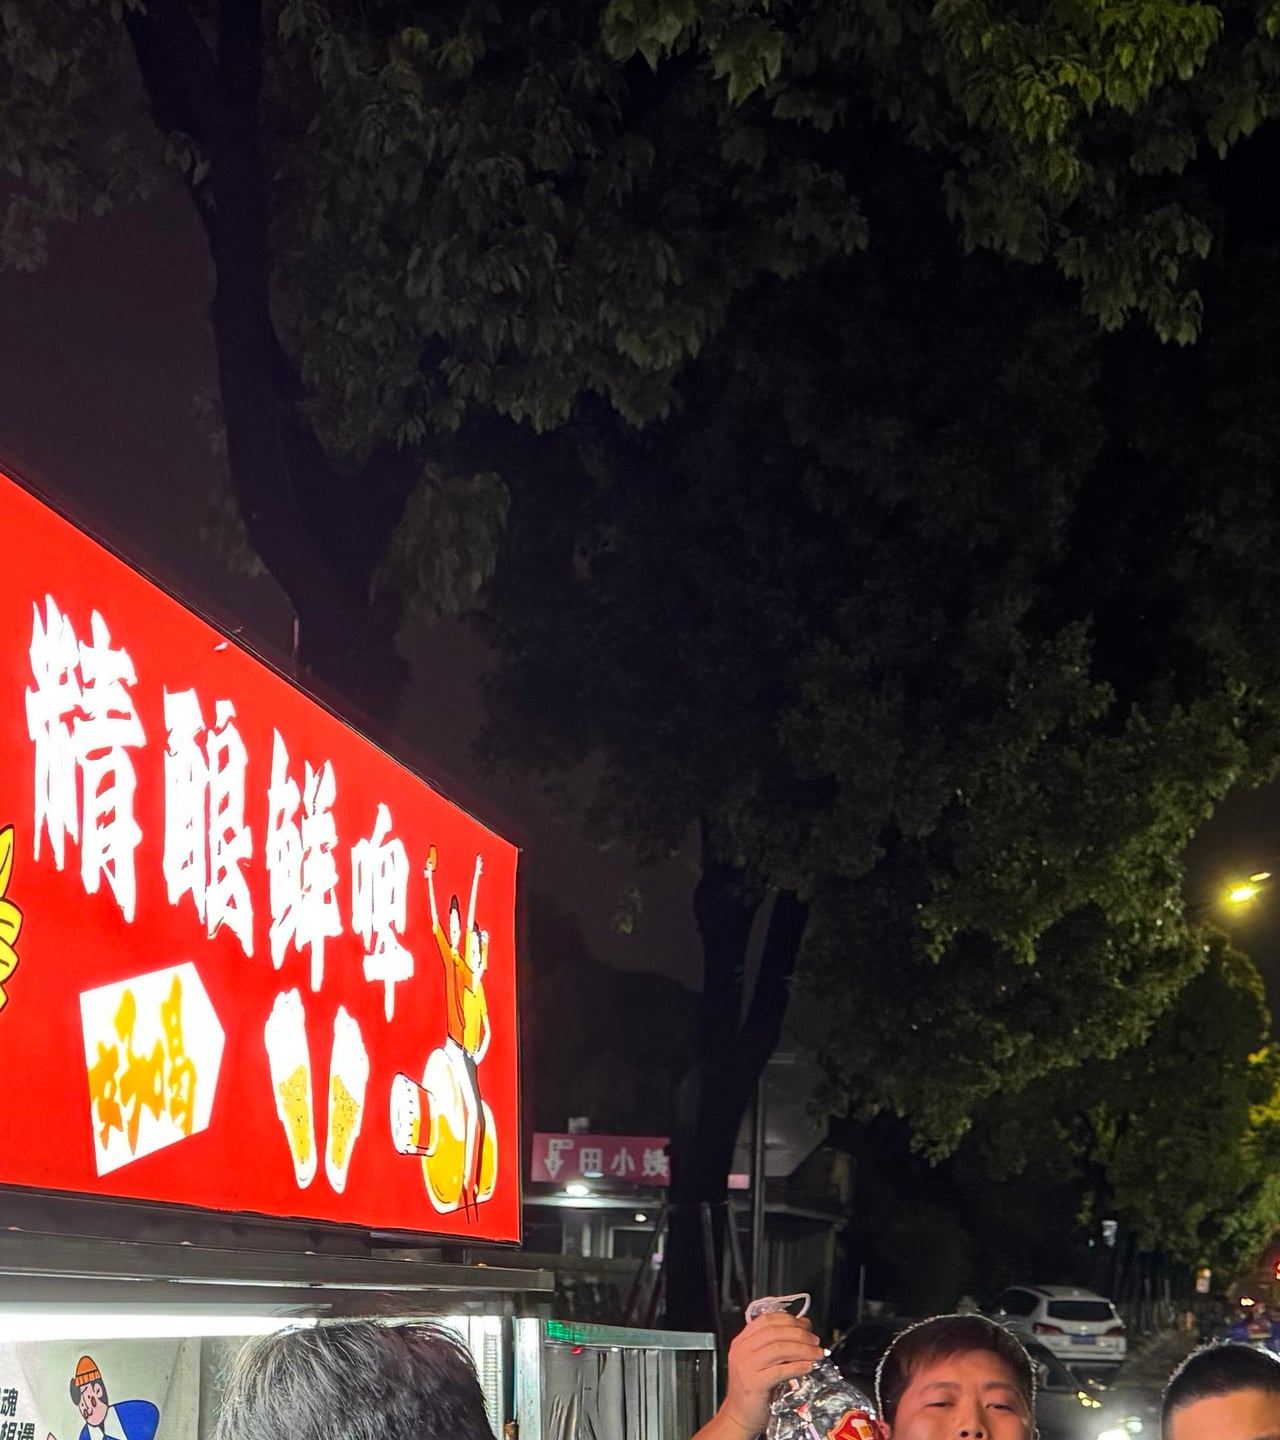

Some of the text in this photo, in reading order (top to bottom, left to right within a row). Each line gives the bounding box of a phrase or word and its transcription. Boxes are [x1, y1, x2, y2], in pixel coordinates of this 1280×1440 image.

[25, 594, 414, 1023] 精酿鲜啤
[88, 974, 197, 1157] 好喝
